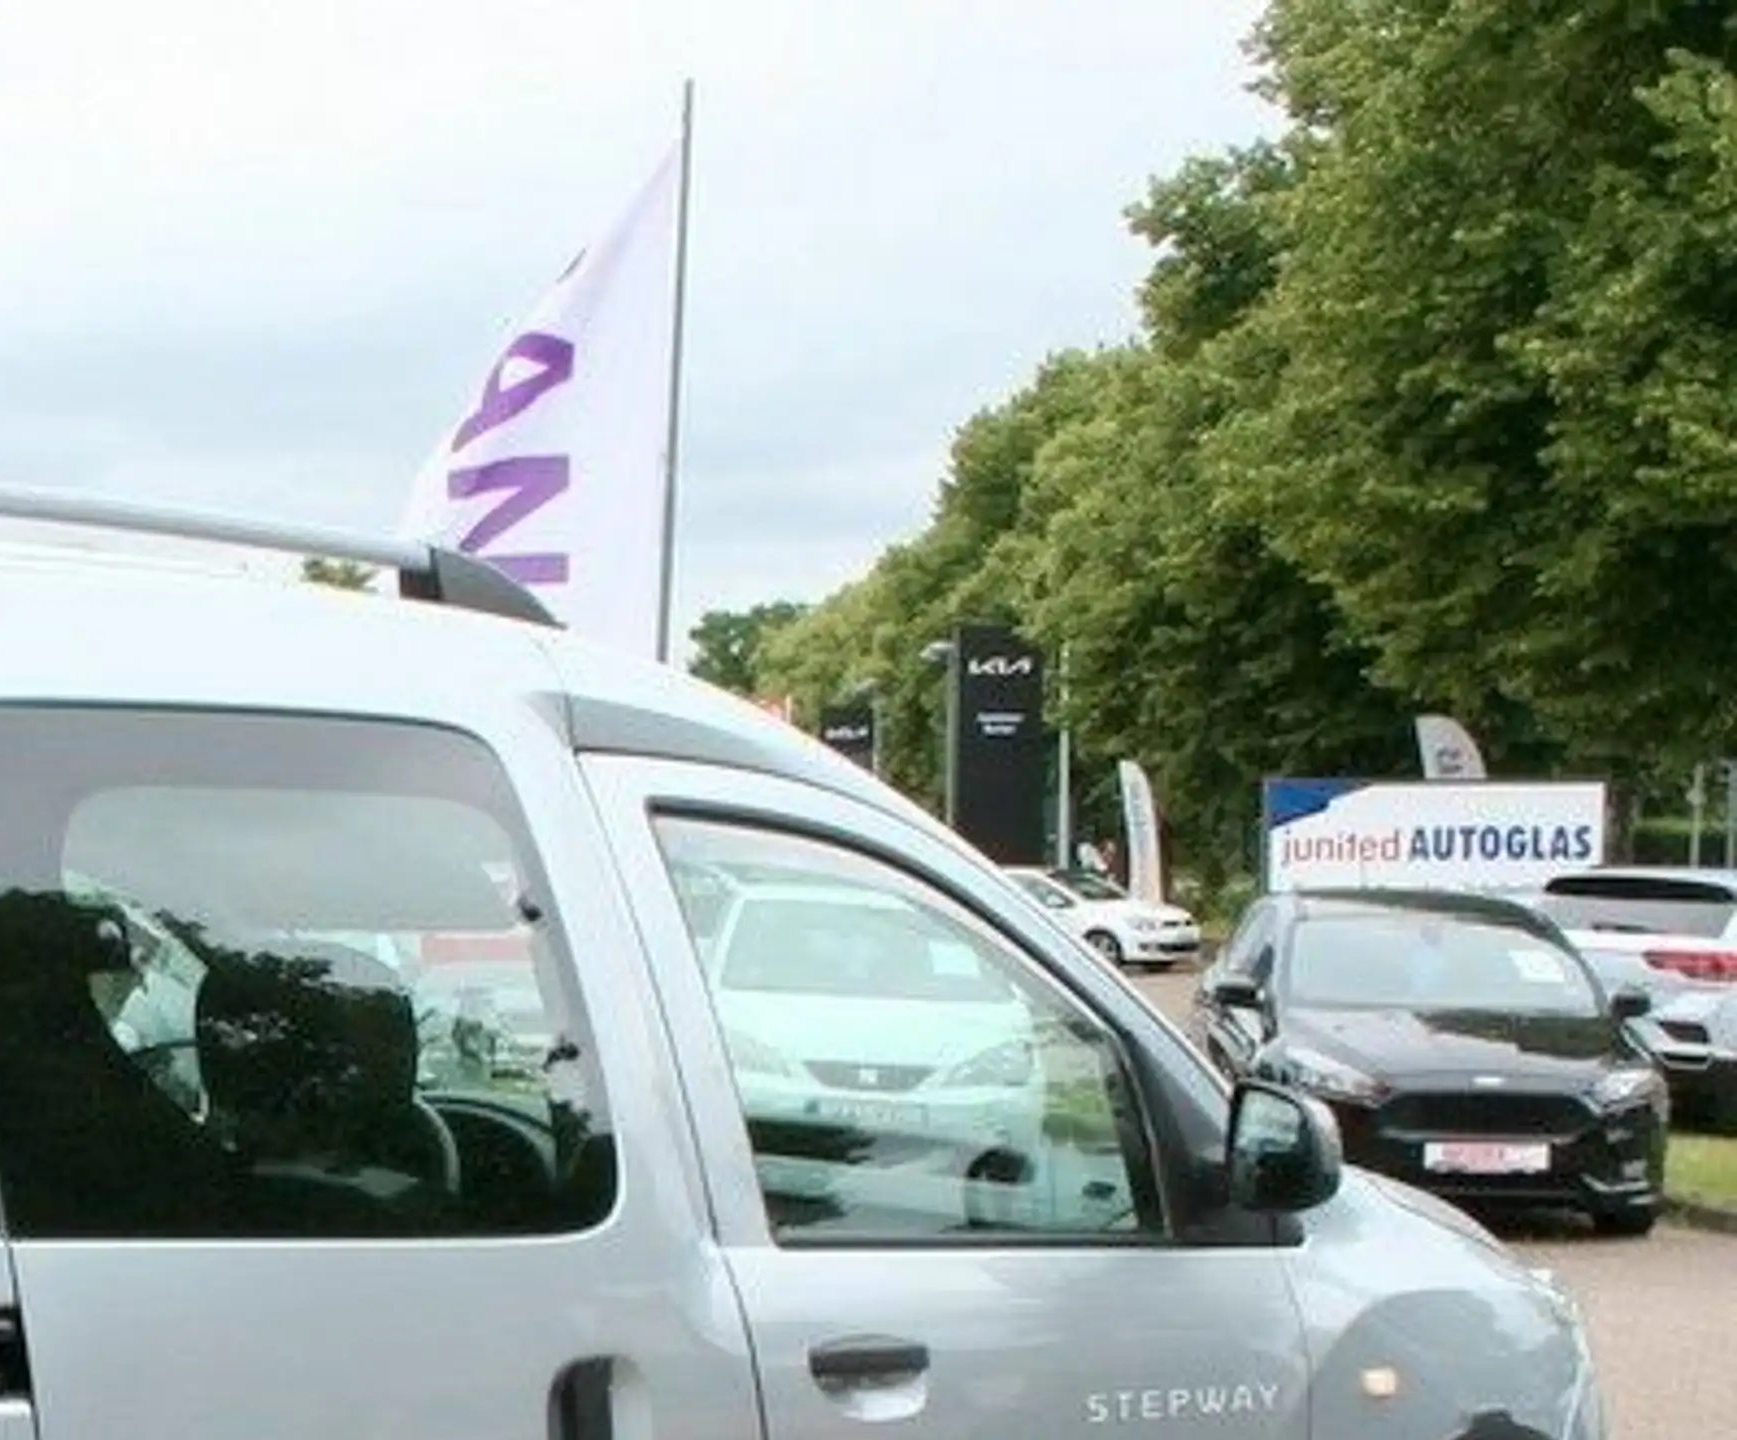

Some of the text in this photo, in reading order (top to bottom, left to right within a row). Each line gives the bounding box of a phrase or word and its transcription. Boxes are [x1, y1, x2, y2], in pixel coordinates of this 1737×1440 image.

[1281, 824, 1593, 867] junited AUTOGLAS
[1086, 1383, 1279, 1424] STEPWAY
